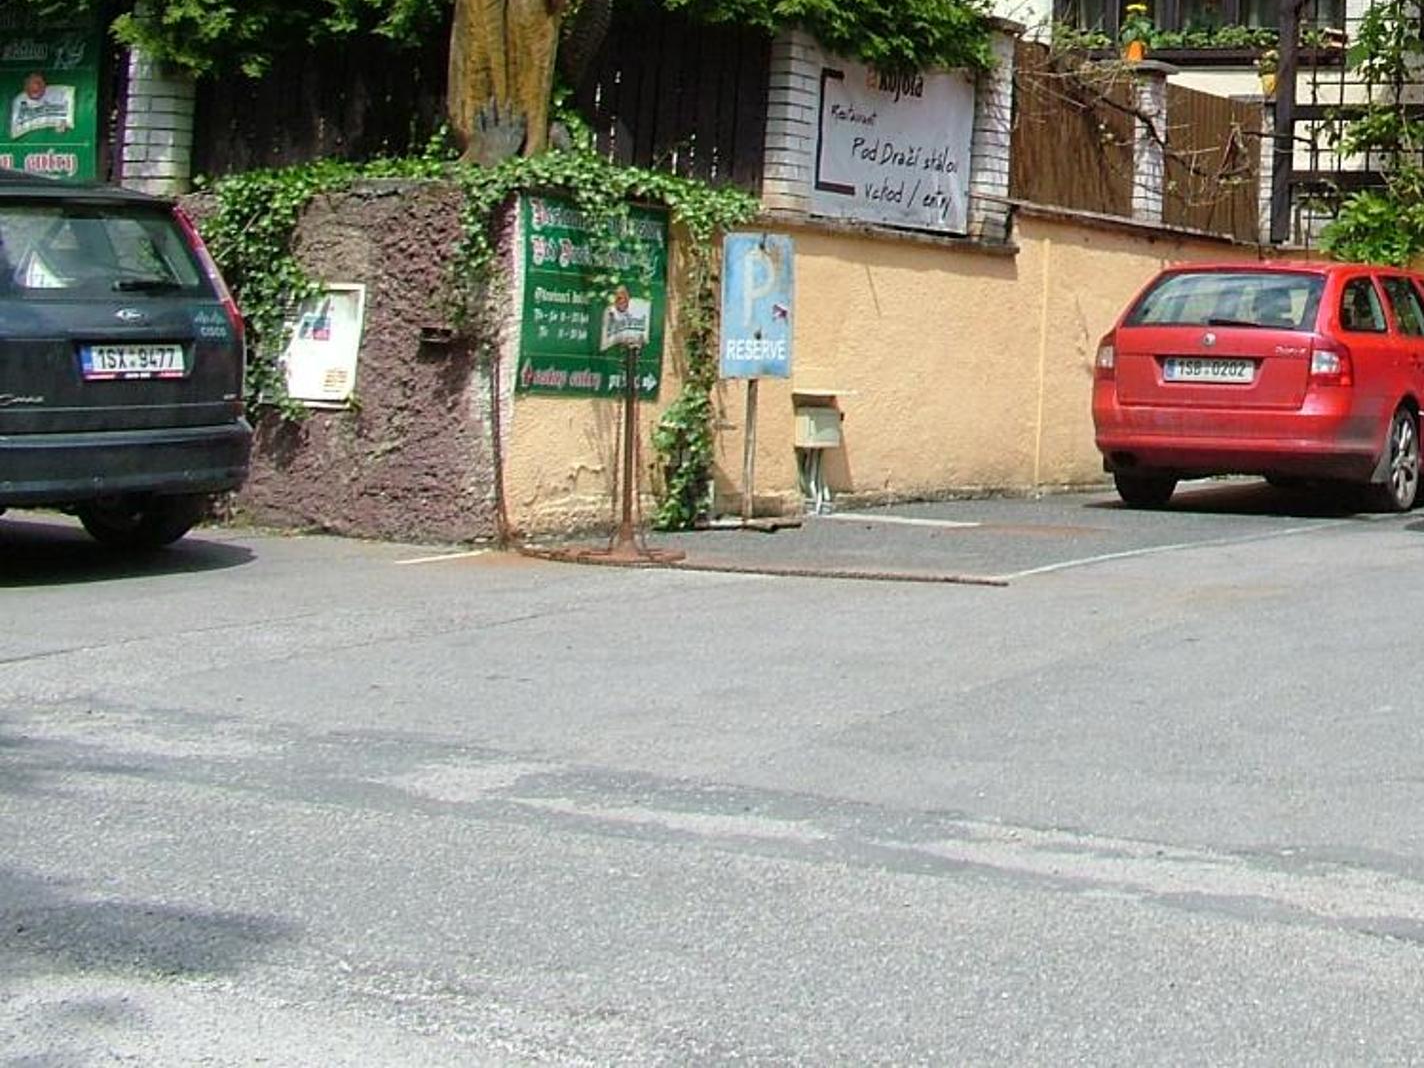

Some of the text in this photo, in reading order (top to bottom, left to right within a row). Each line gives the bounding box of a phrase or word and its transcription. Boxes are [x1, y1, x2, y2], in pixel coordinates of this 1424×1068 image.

[852, 137, 880, 162] Pod
[880, 143, 920, 167] Dračí
[743, 249, 776, 329] P
[98, 346, 176, 370] 1SX 9477
[726, 338, 787, 361] RESERVE
